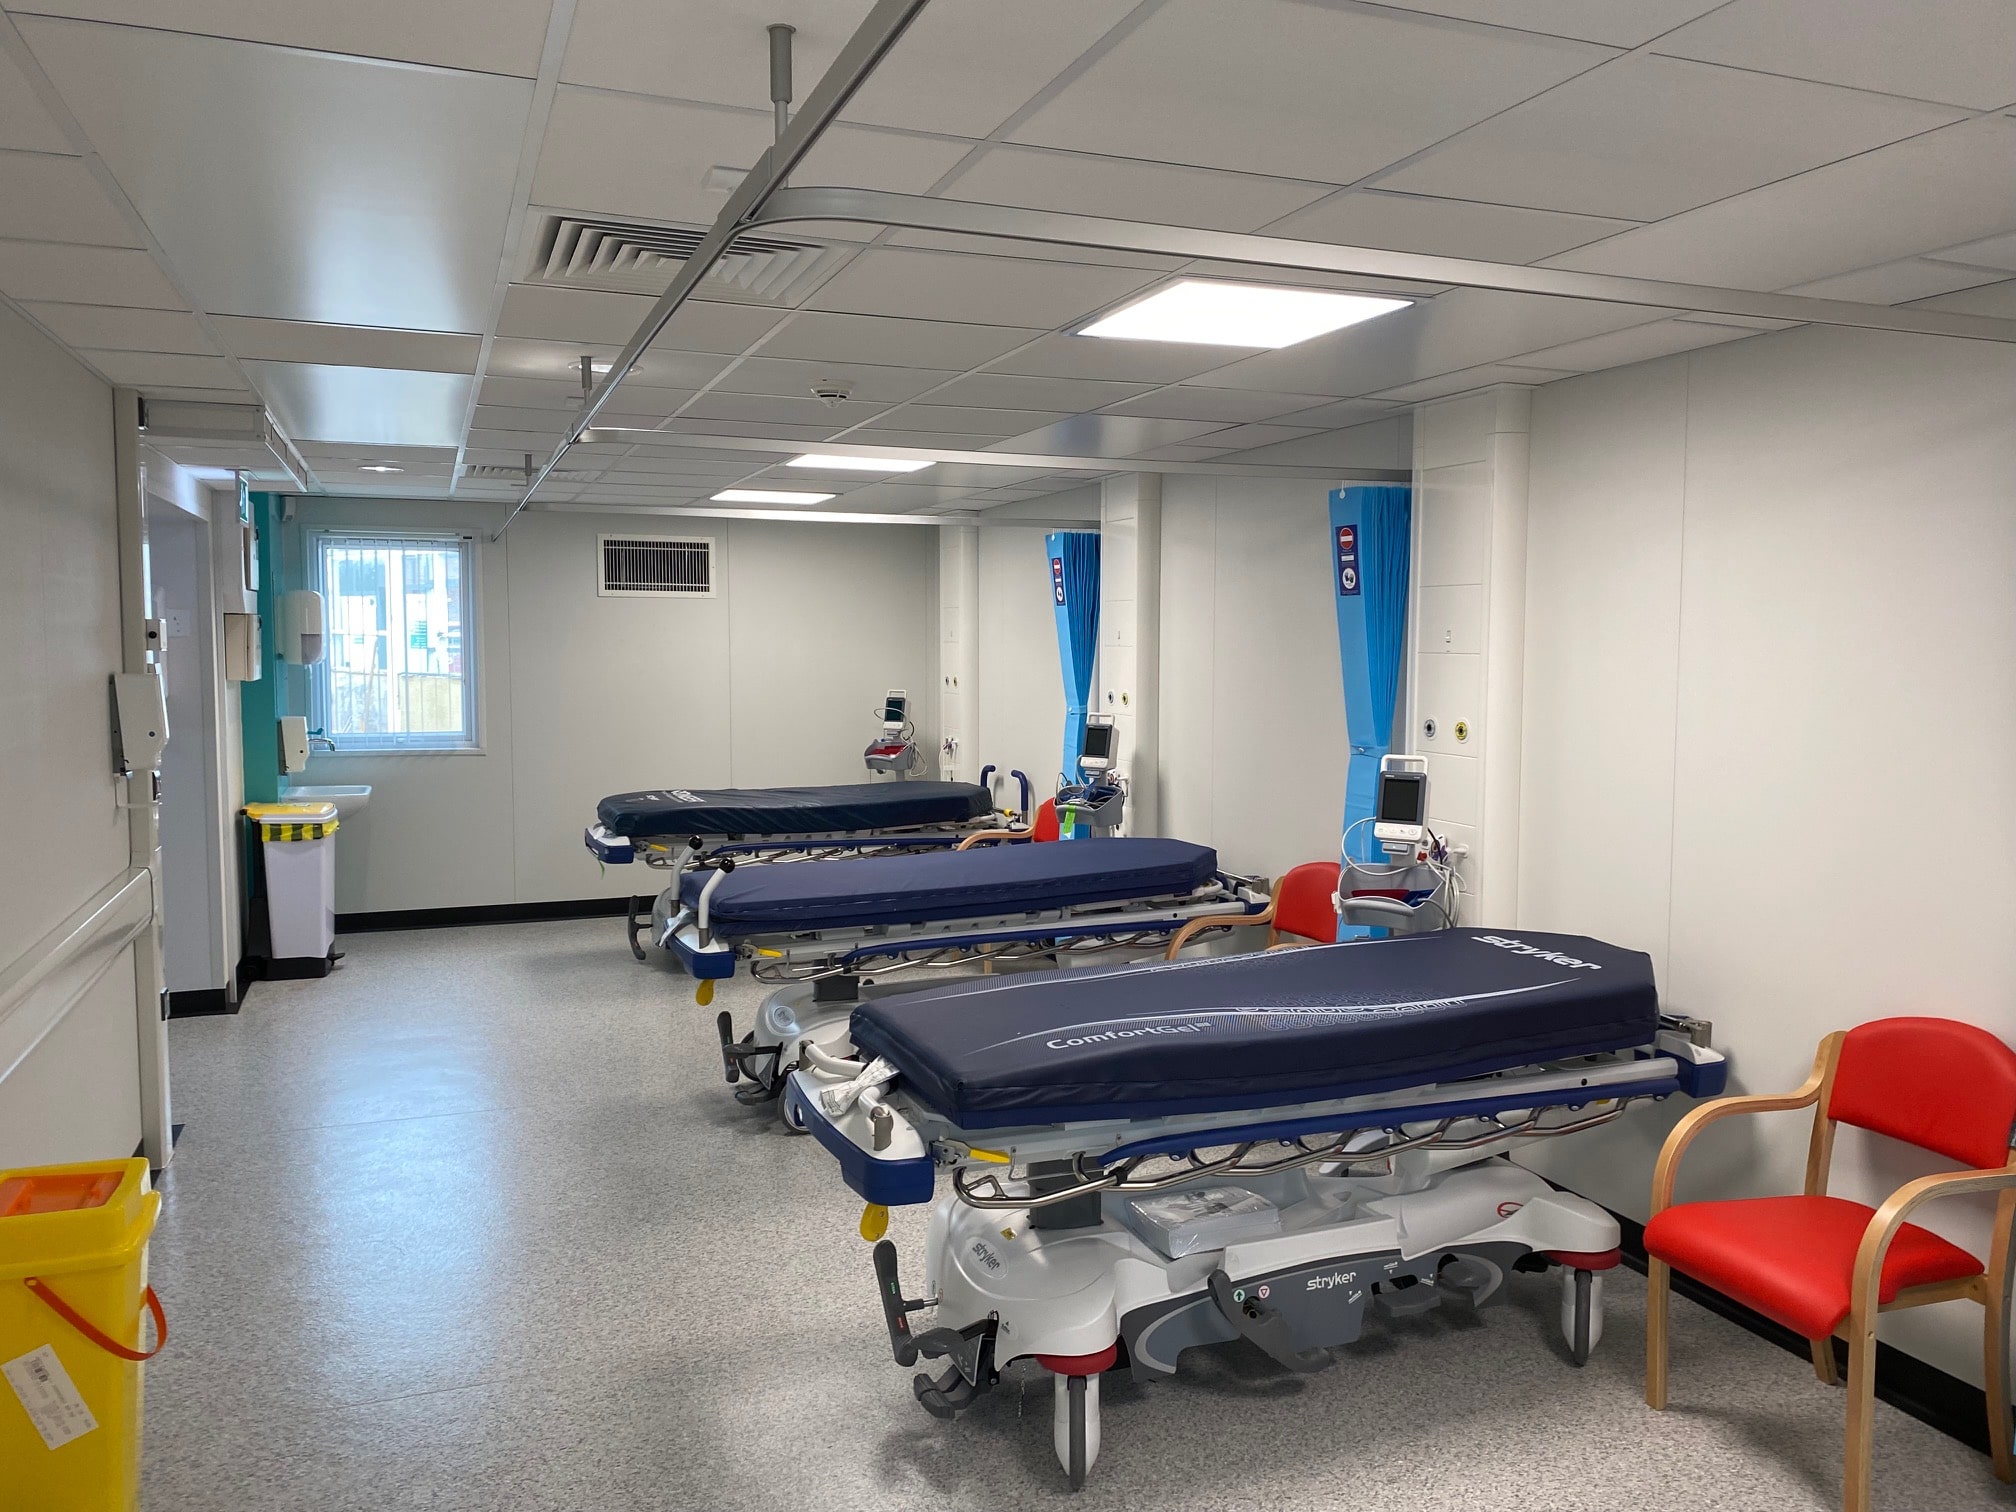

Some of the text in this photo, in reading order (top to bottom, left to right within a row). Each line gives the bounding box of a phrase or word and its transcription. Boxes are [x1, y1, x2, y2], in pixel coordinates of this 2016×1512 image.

[1471, 935, 1602, 970] stryker
[972, 1242, 1001, 1271] stryker
[1306, 1271, 1357, 1291] stryker
